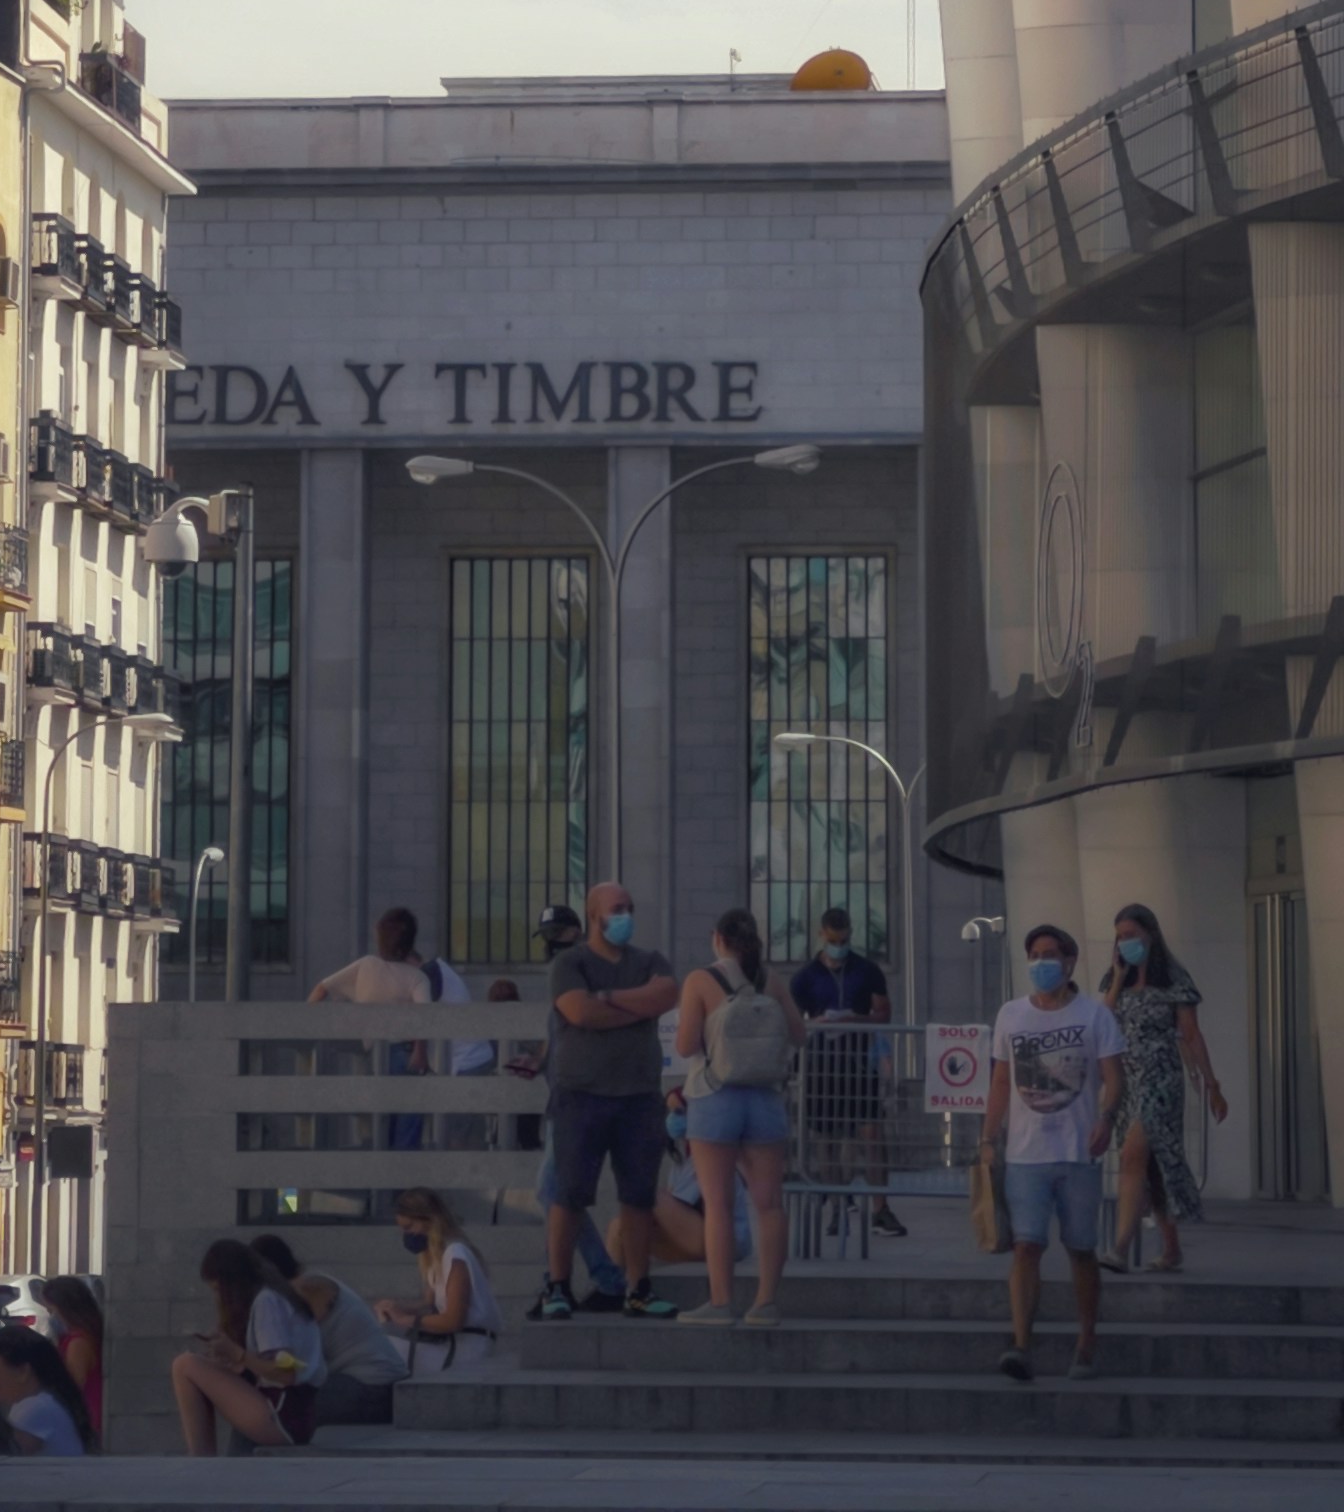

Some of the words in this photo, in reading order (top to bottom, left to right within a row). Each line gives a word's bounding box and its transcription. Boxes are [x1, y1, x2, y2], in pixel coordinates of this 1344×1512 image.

[343, 360, 406, 425] Y
[434, 359, 765, 425] TIMBRE
[938, 1026, 979, 1039] SOLO
[931, 1094, 985, 1107] SALIDA
